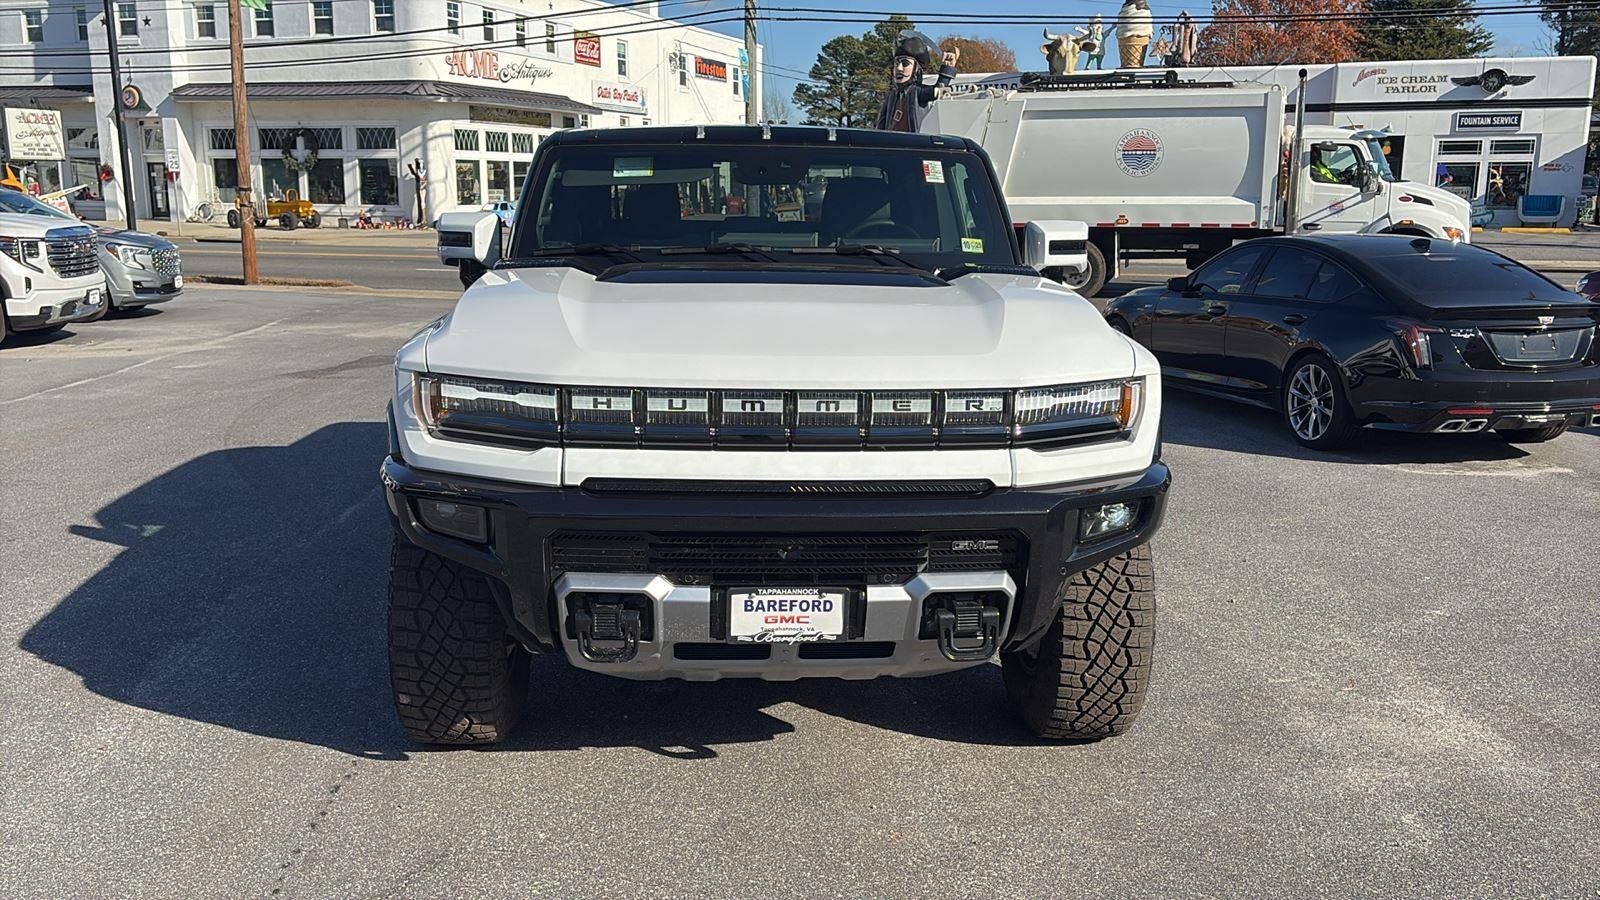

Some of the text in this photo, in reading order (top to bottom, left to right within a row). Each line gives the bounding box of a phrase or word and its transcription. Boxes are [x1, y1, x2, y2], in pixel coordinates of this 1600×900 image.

[446, 48, 553, 86] ACME Antiques
[696, 59, 726, 78] Firestone
[1377, 74, 1448, 85] ICE CREAM
[1384, 85, 1437, 94] PARLOR
[1460, 116, 1519, 125] FOUNTAIN SERVICE
[169, 160, 179, 169] 25
[593, 397, 985, 412] HUMMER
[952, 540, 998, 550] GMC
[744, 599, 834, 612] BAREFORD
[764, 615, 810, 624] GMC
[754, 631, 822, 645] Bareford
